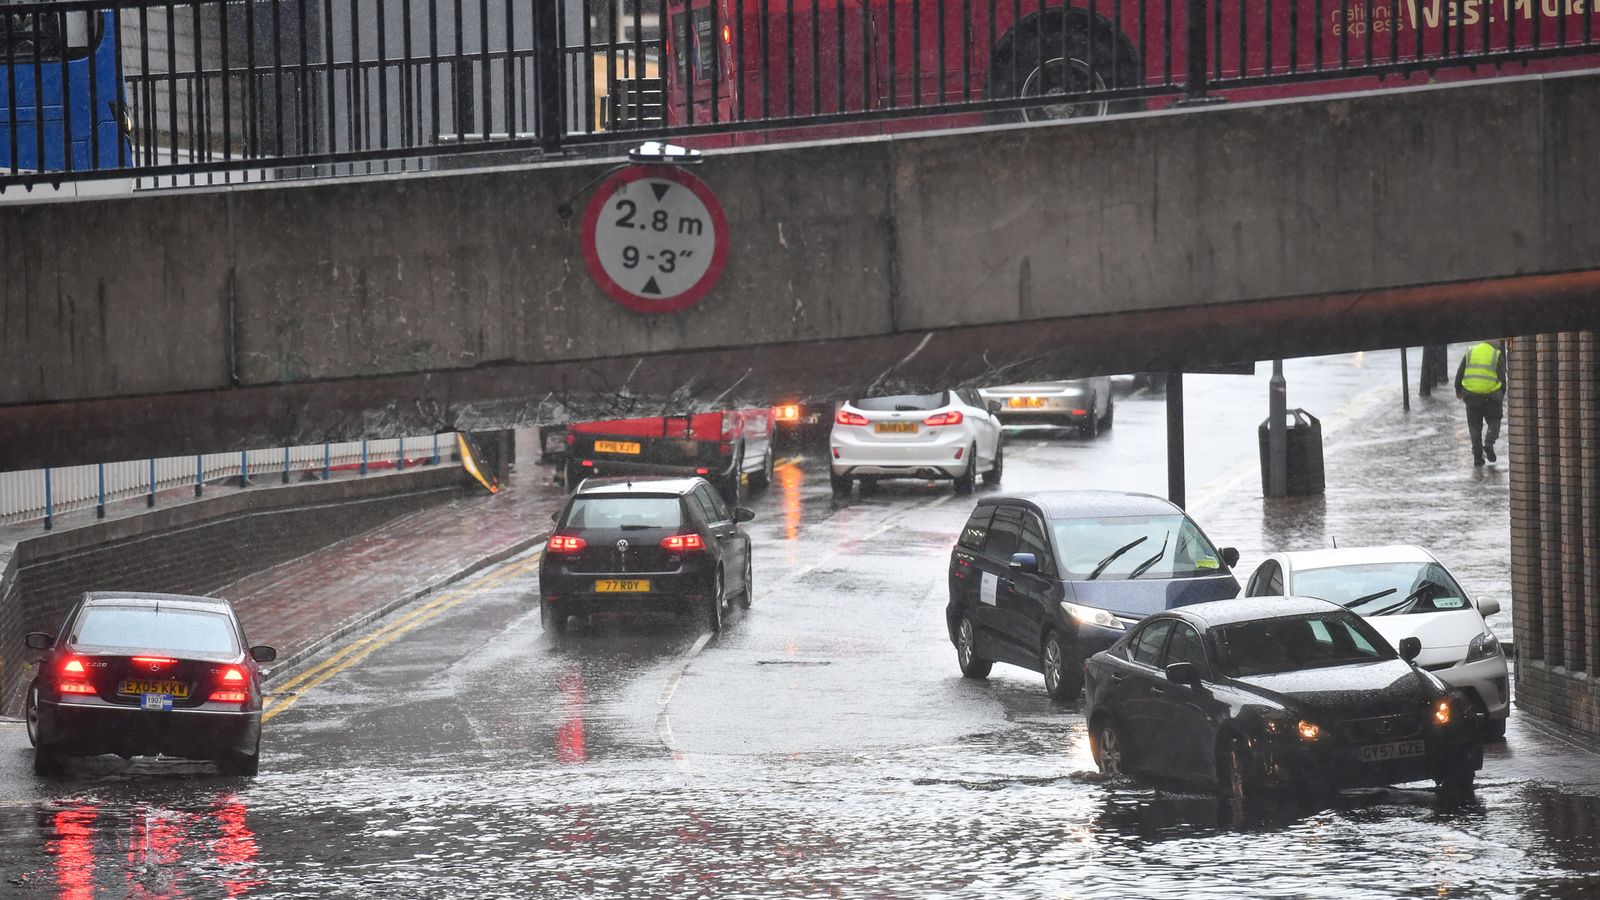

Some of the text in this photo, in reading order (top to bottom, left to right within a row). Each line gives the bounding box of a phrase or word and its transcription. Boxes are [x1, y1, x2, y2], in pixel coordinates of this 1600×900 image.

[1331, 1, 1402, 22] natinl
[1332, 17, 1404, 39] expess
[615, 199, 703, 236] 2.8 m
[605, 581, 640, 591] 77 RDY
[125, 679, 187, 698] EX05 KKW
[147, 696, 163, 705] 1907
[1363, 741, 1424, 760] GY57 GZE
